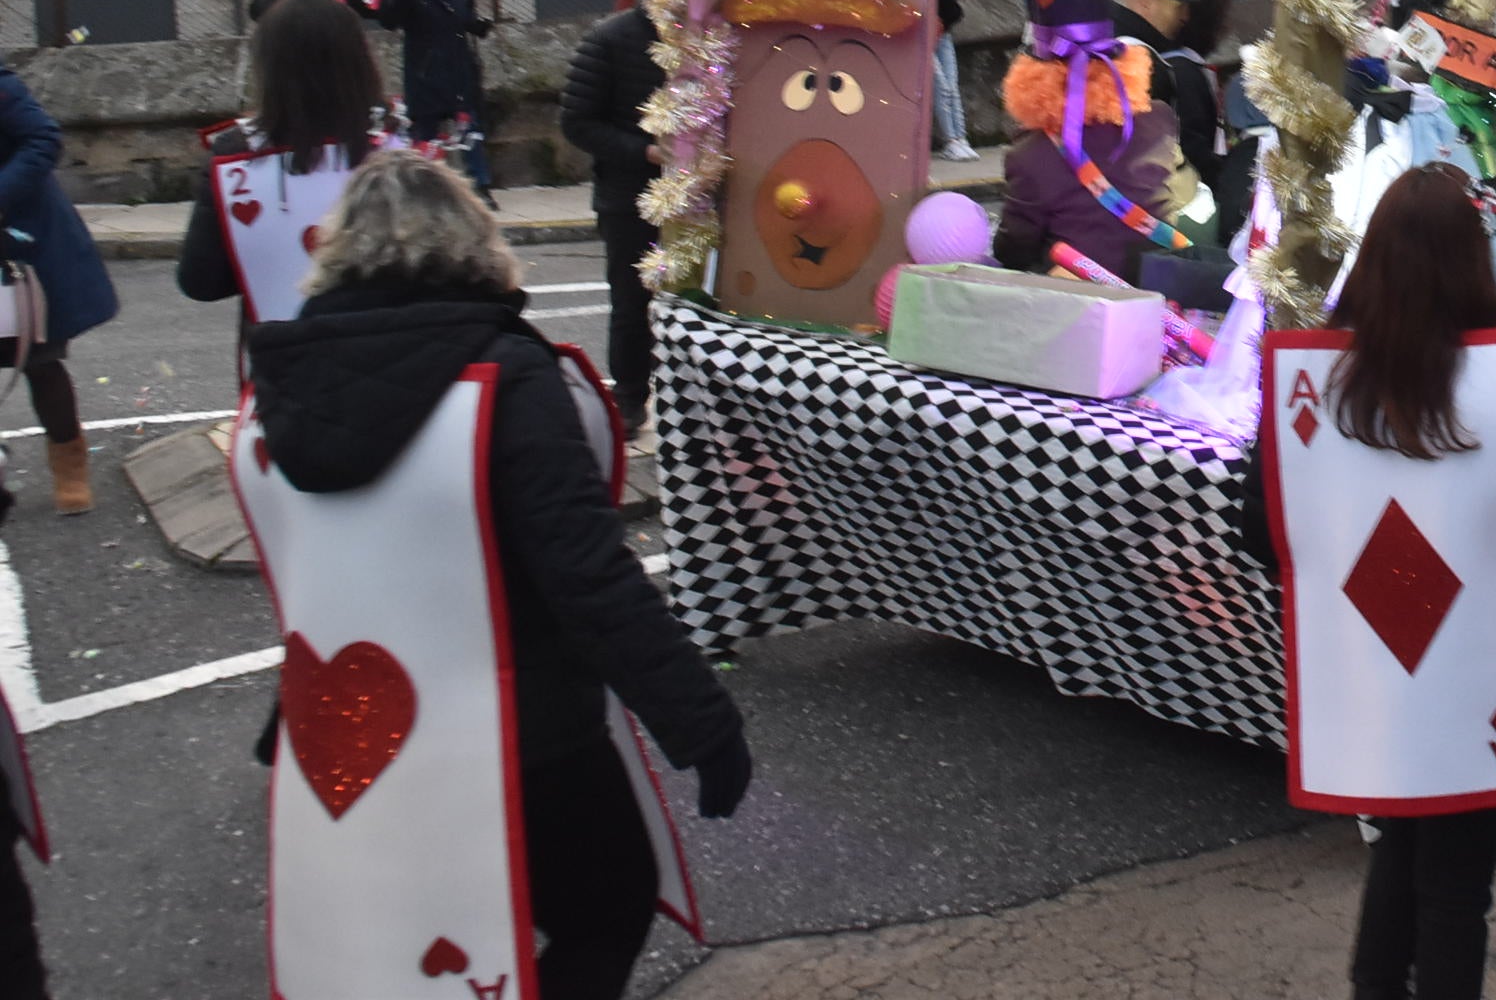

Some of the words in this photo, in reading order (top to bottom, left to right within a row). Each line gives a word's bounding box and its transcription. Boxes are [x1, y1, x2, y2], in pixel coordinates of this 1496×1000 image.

[1437, 28, 1476, 66] OR
[227, 167, 252, 196] 2
[1286, 368, 1320, 409] A
